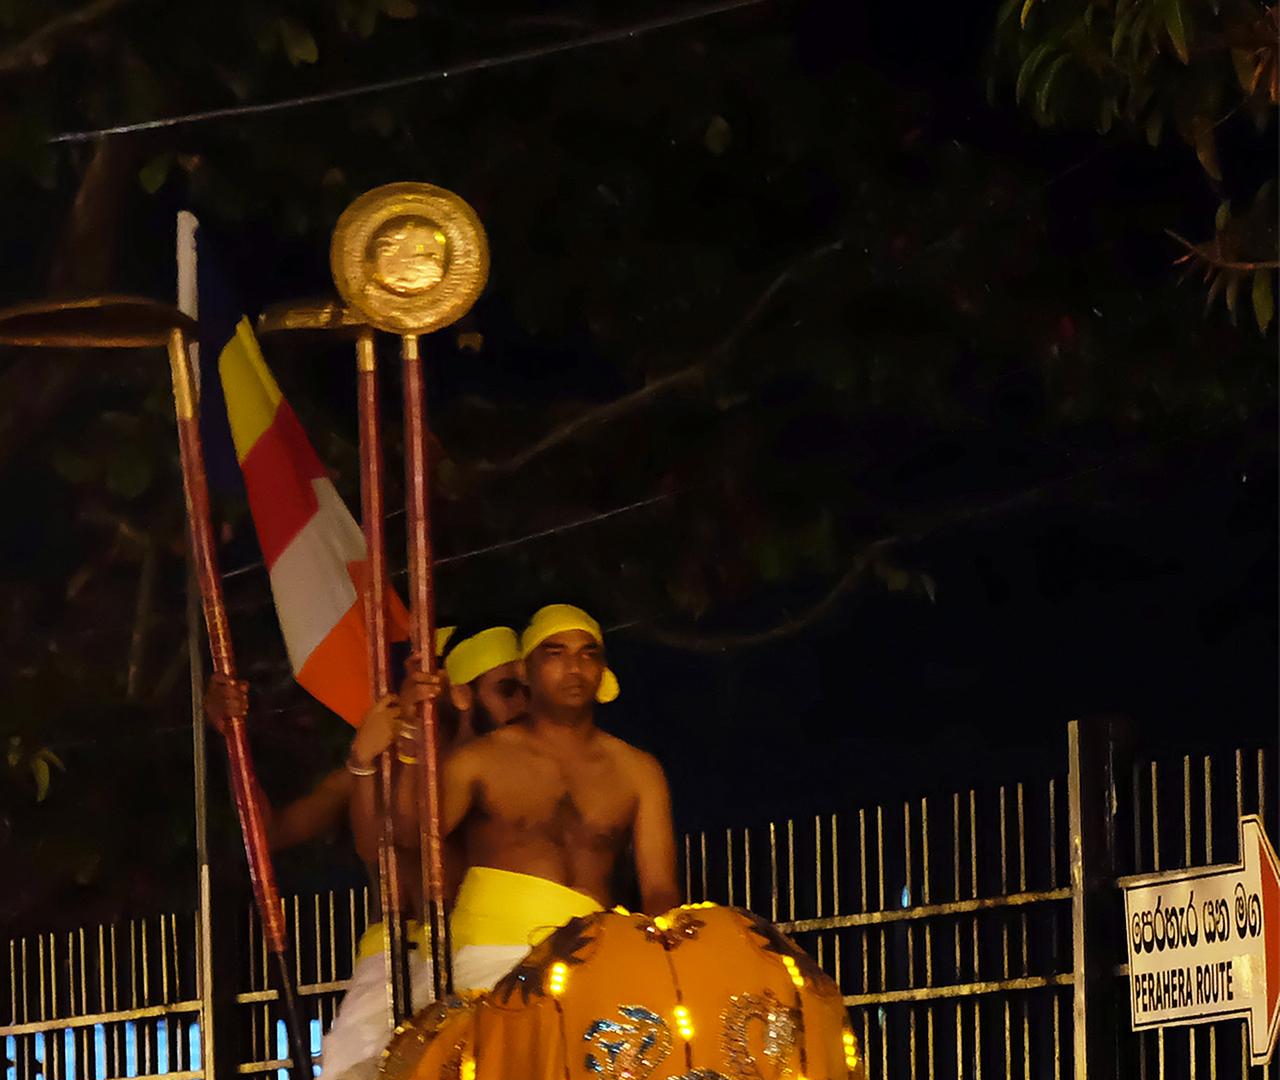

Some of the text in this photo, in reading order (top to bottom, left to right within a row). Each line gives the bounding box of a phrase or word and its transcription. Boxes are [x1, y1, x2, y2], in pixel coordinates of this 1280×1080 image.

[1203, 898, 1230, 944] යන
[1234, 882, 1262, 939] මග
[1134, 961, 1234, 1013] PERAHERA ROUTE
